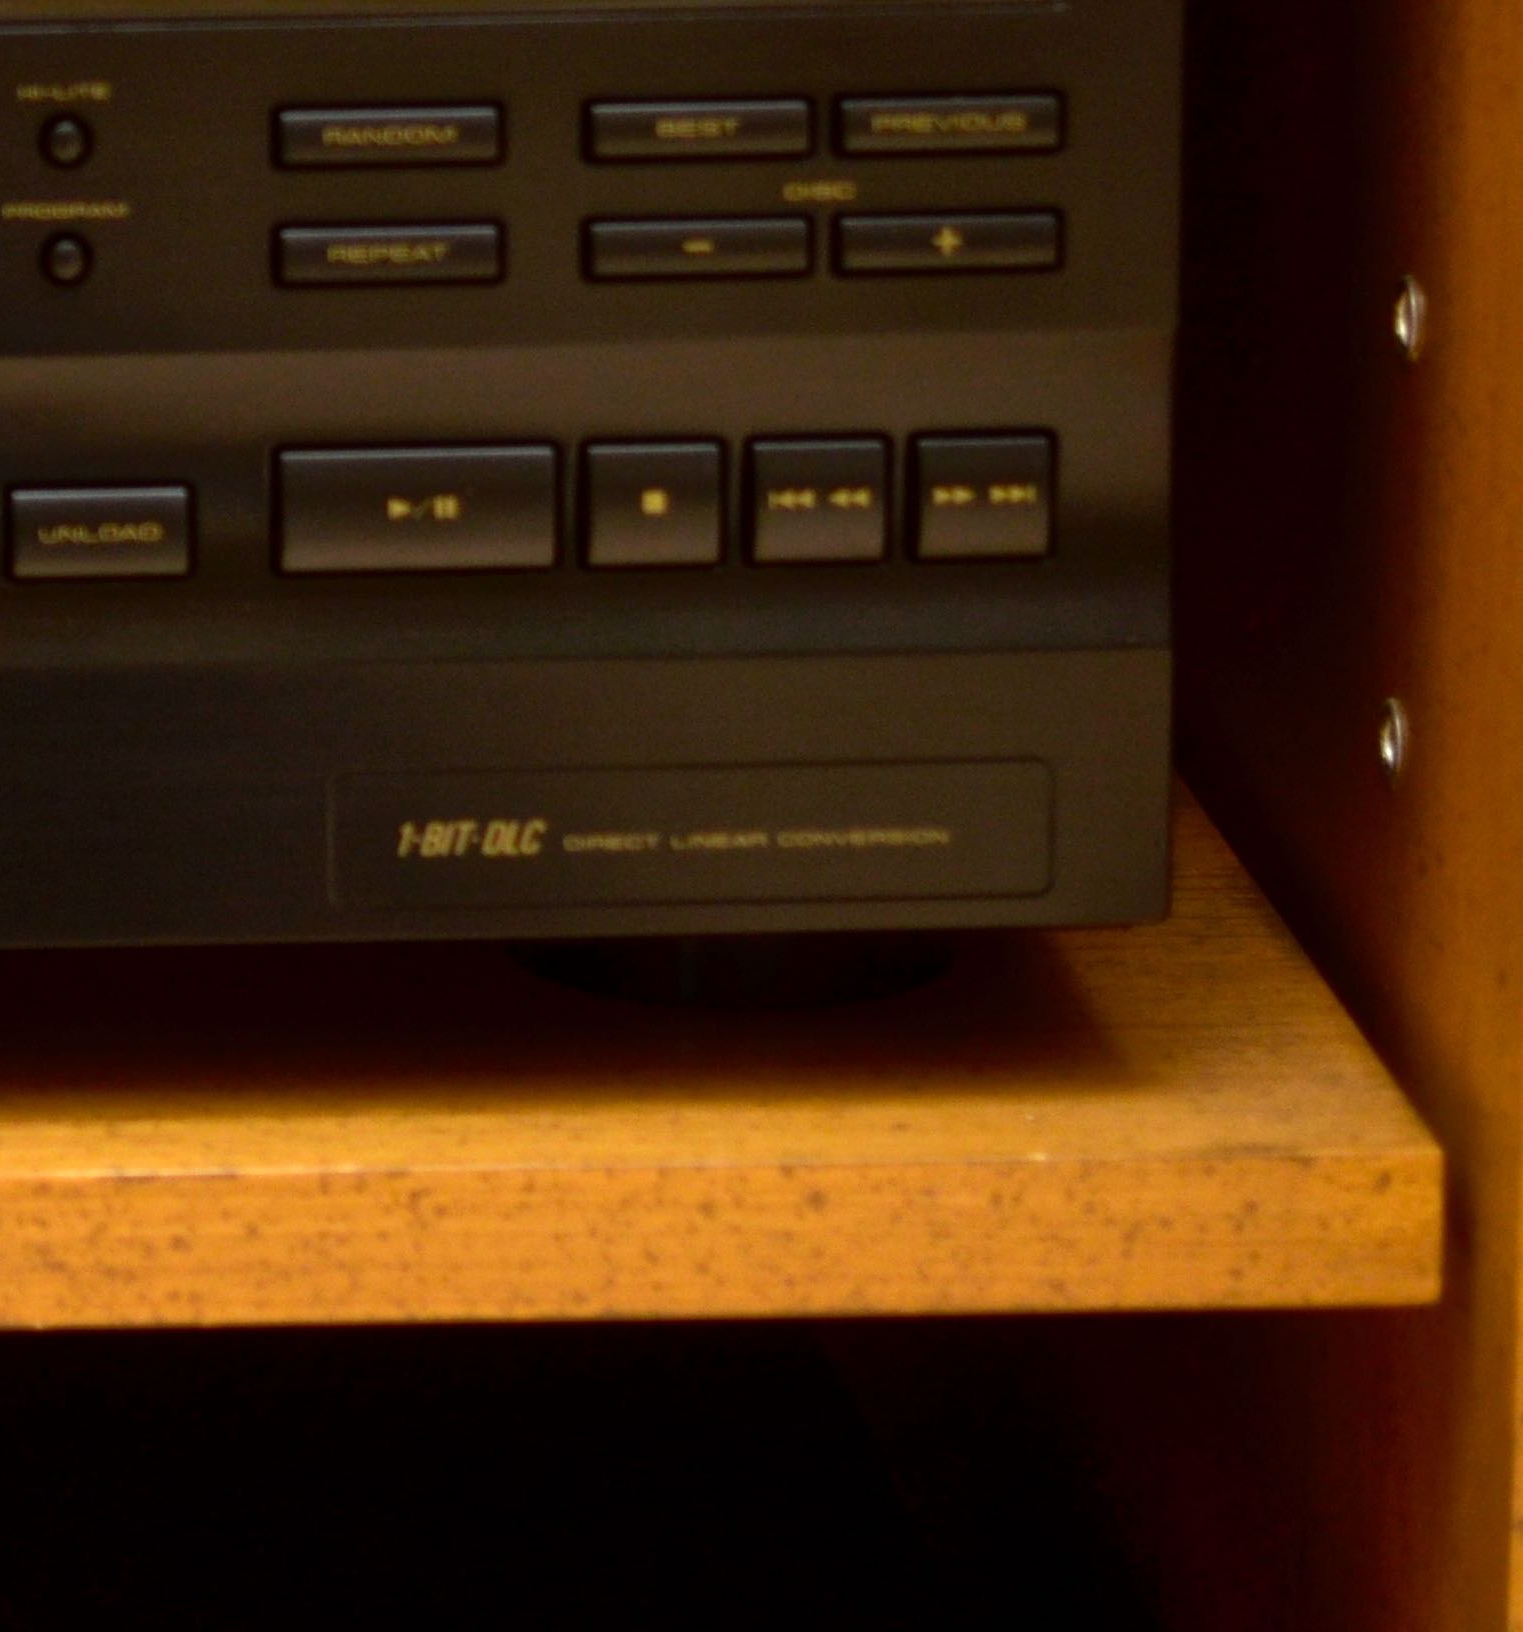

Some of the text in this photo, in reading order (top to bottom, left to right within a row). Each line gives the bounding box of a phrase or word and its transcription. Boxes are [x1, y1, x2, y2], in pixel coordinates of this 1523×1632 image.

[655, 116, 742, 139] BEST
[872, 112, 1026, 135] PREVIOUS
[322, 124, 458, 148] RANDOM
[326, 243, 451, 265] REPEAT
[37, 521, 163, 544] UNLOAD
